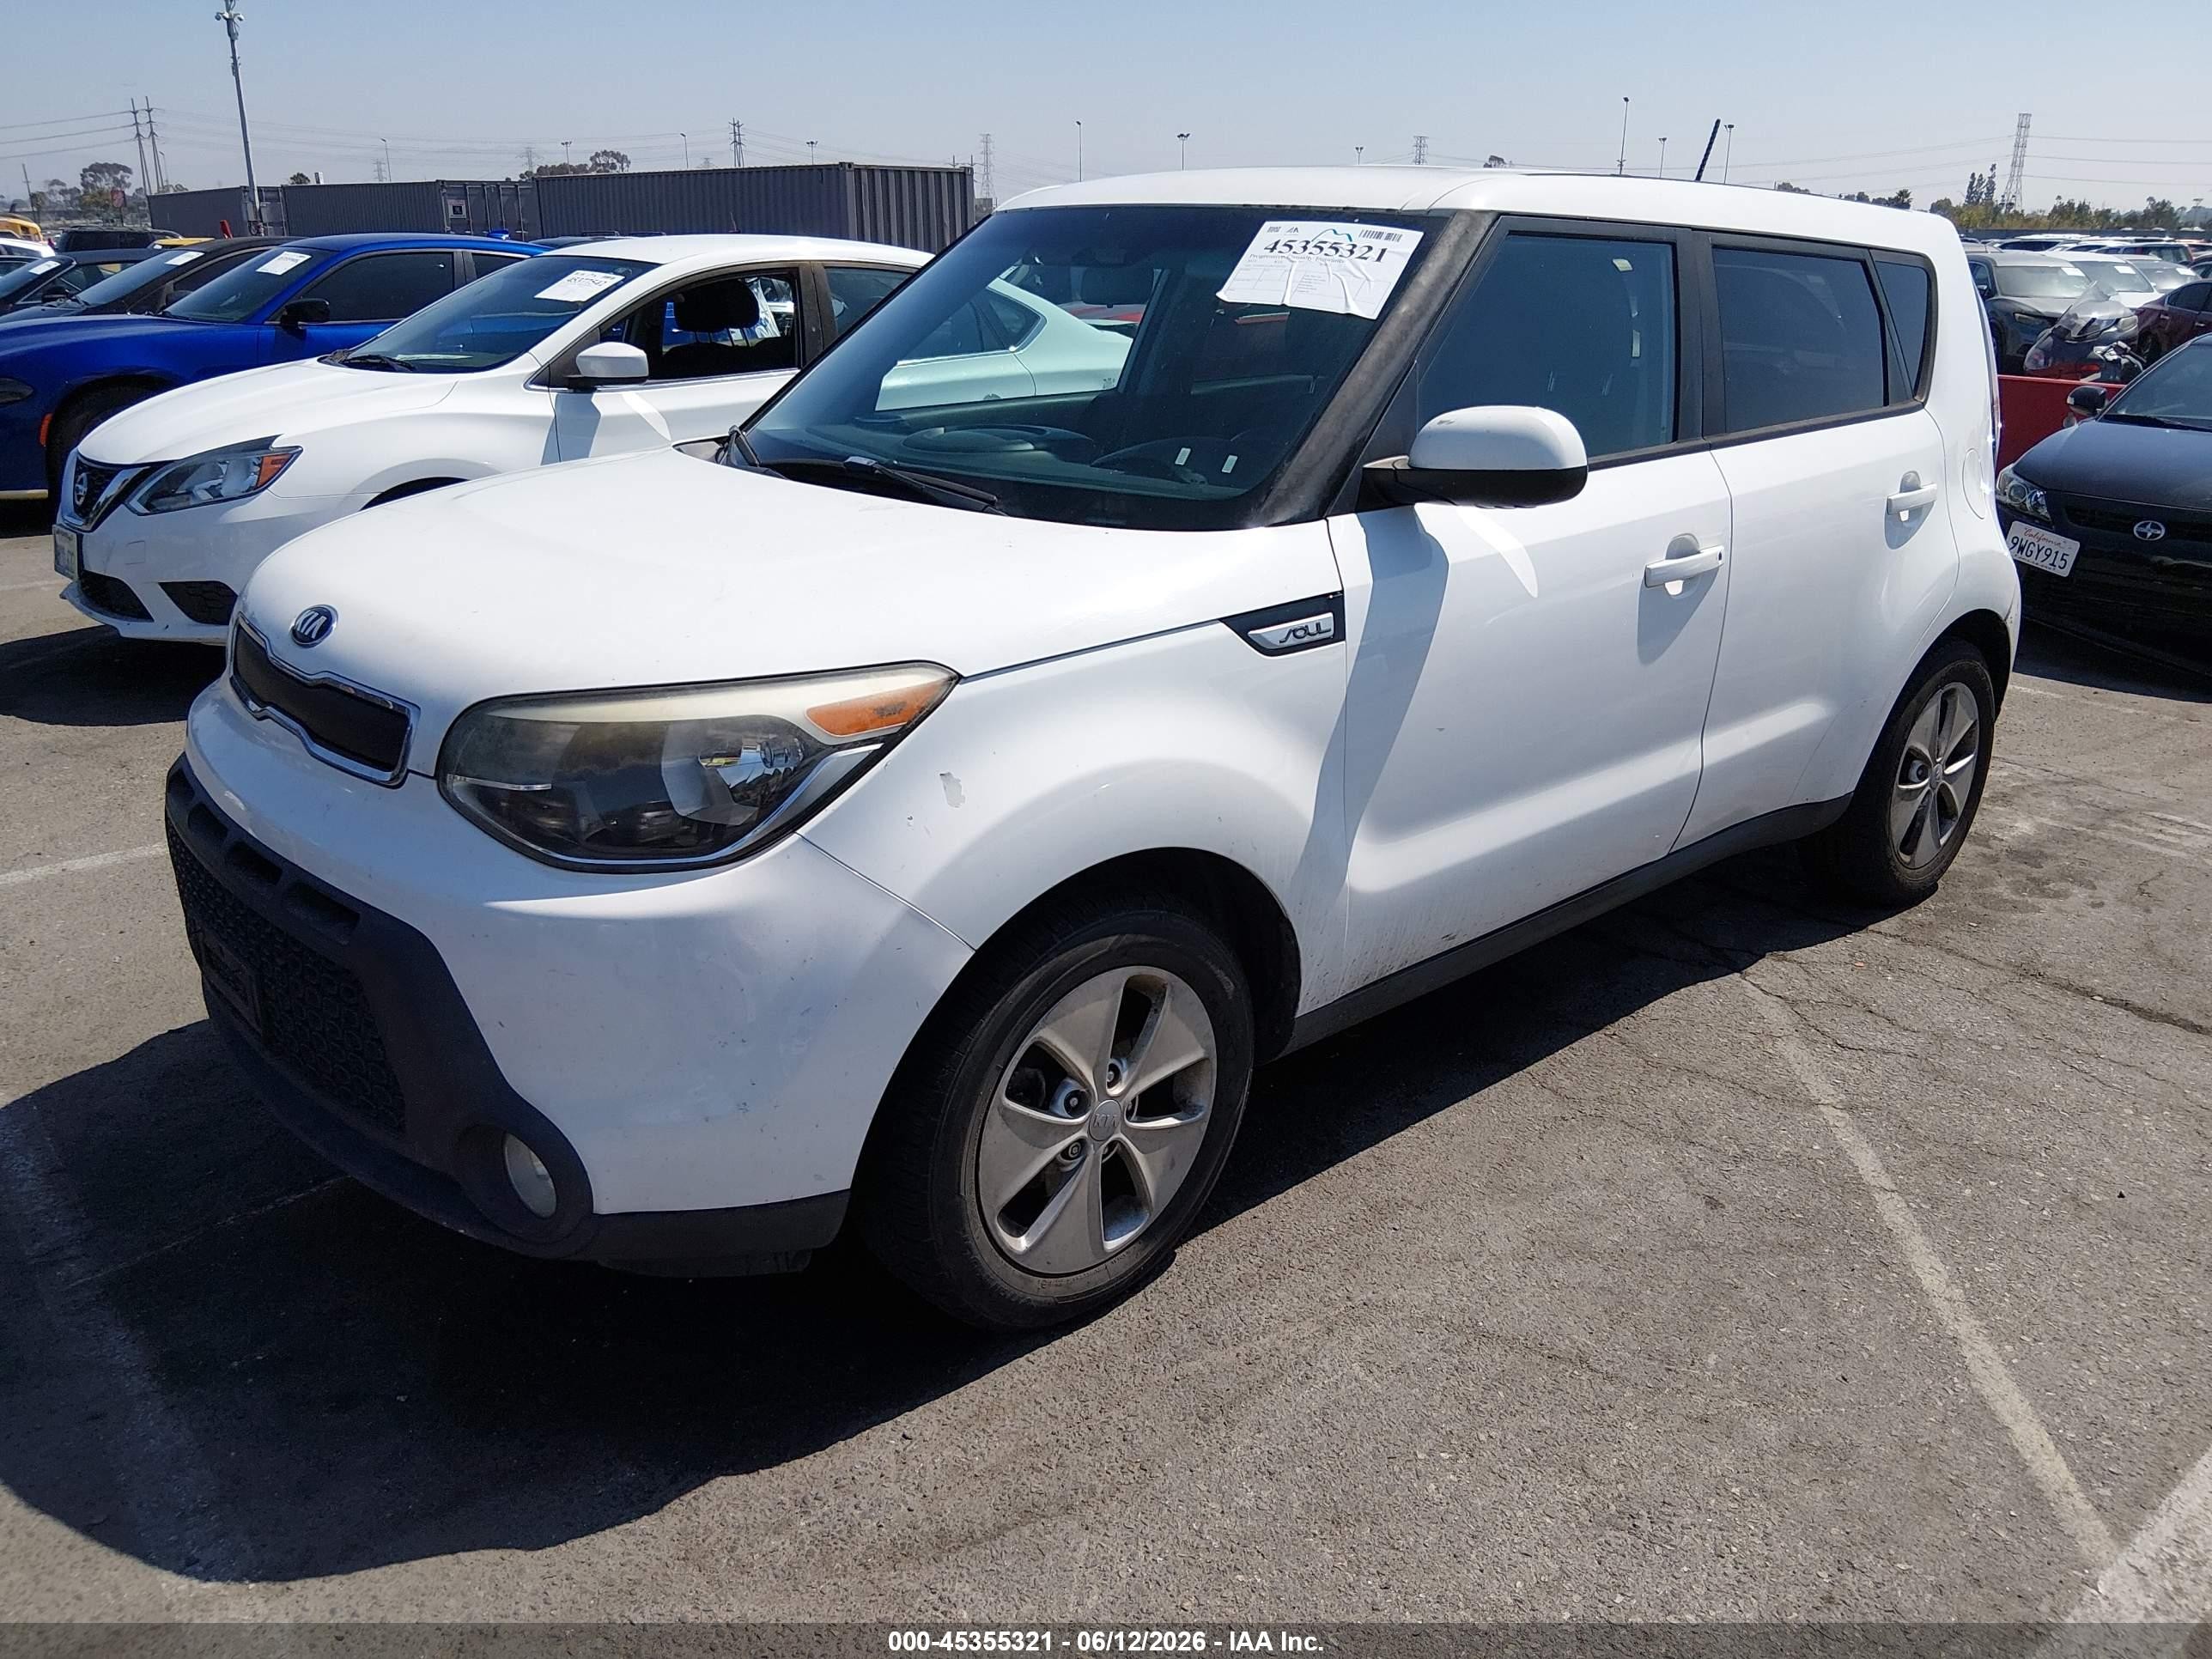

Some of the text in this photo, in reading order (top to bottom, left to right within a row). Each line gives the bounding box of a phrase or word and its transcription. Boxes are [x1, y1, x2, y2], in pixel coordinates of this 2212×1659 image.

[1264, 239, 1389, 263] 45355321
[2024, 527, 2062, 547] California
[2009, 536, 2069, 569] 9WGY915
[295, 610, 327, 640] KIA
[1093, 1113, 1118, 1127] KIA
